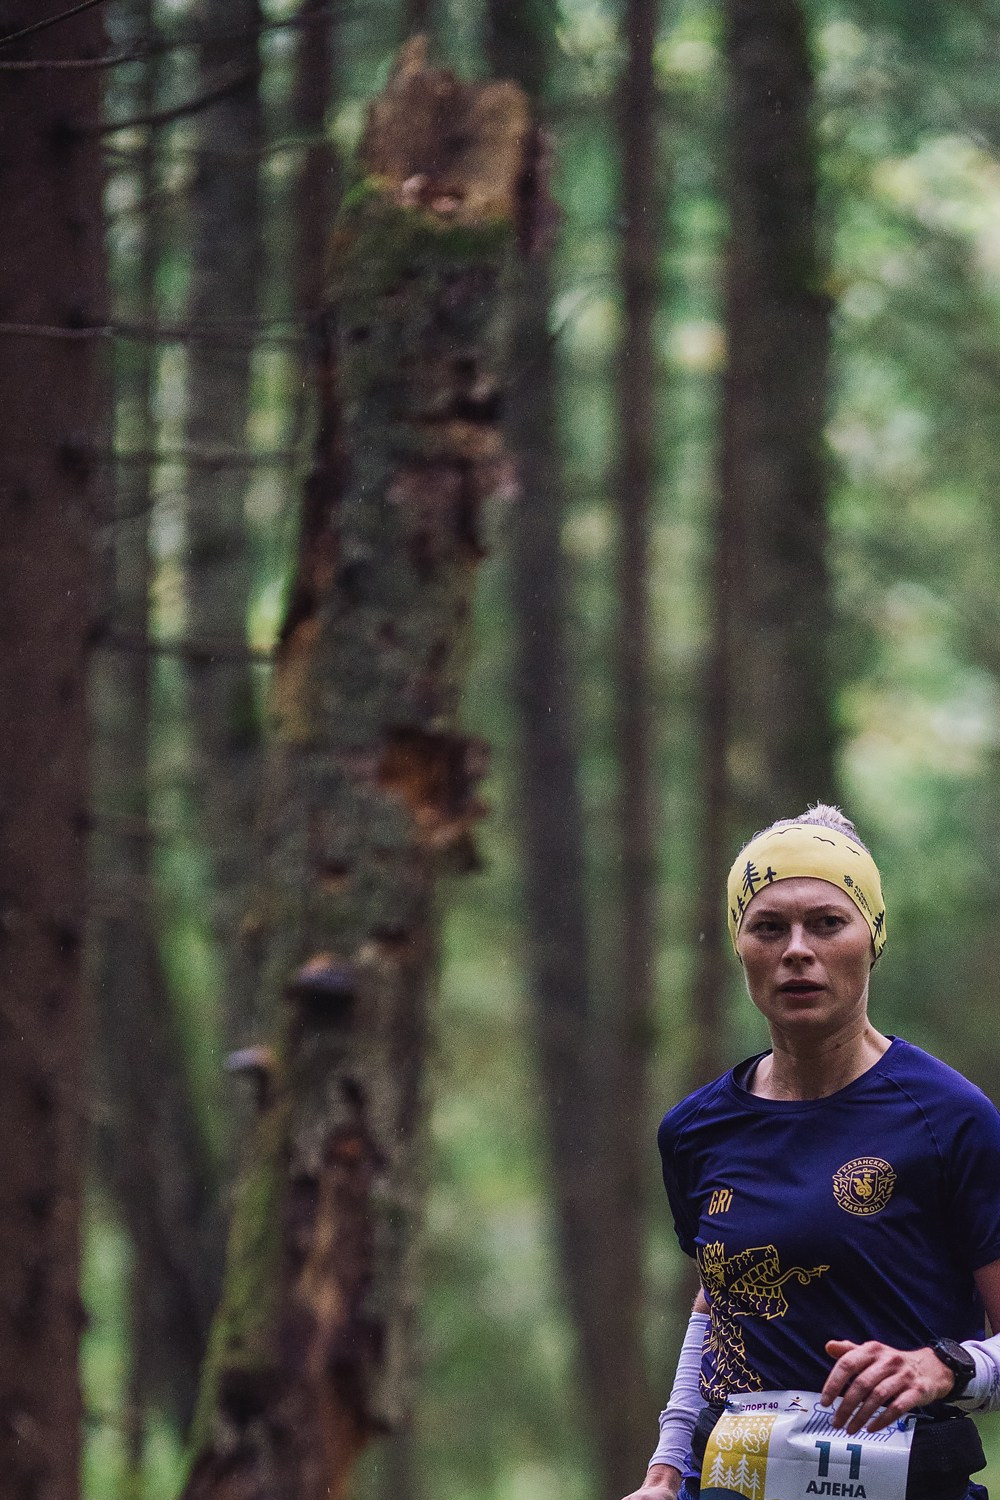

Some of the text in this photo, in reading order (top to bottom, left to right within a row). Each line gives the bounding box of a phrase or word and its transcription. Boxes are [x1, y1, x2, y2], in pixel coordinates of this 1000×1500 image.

[842, 1159, 889, 1173] КАЗАНСКИЙ
[841, 1200, 881, 1214] МАРАФОН
[814, 1440, 863, 1480] 11
[805, 1480, 868, 1499] АЛЕНА
